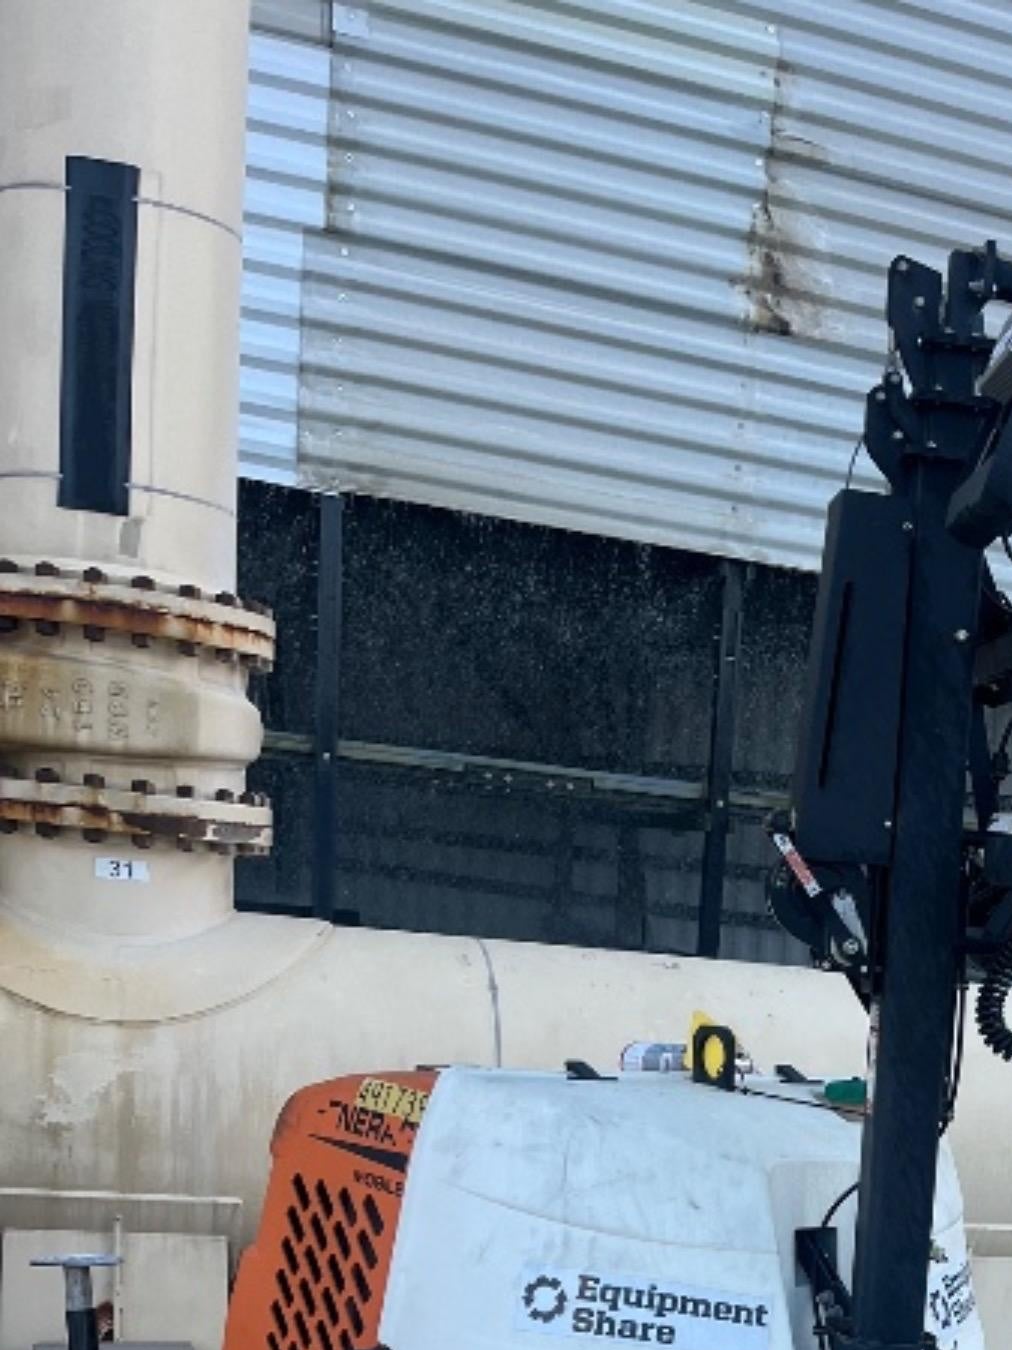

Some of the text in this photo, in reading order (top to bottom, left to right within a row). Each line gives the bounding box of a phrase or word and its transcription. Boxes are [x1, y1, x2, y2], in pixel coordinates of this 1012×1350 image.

[108, 860, 133, 880] 31
[575, 1273, 769, 1327] Equipment
[572, 1307, 676, 1346] Share
